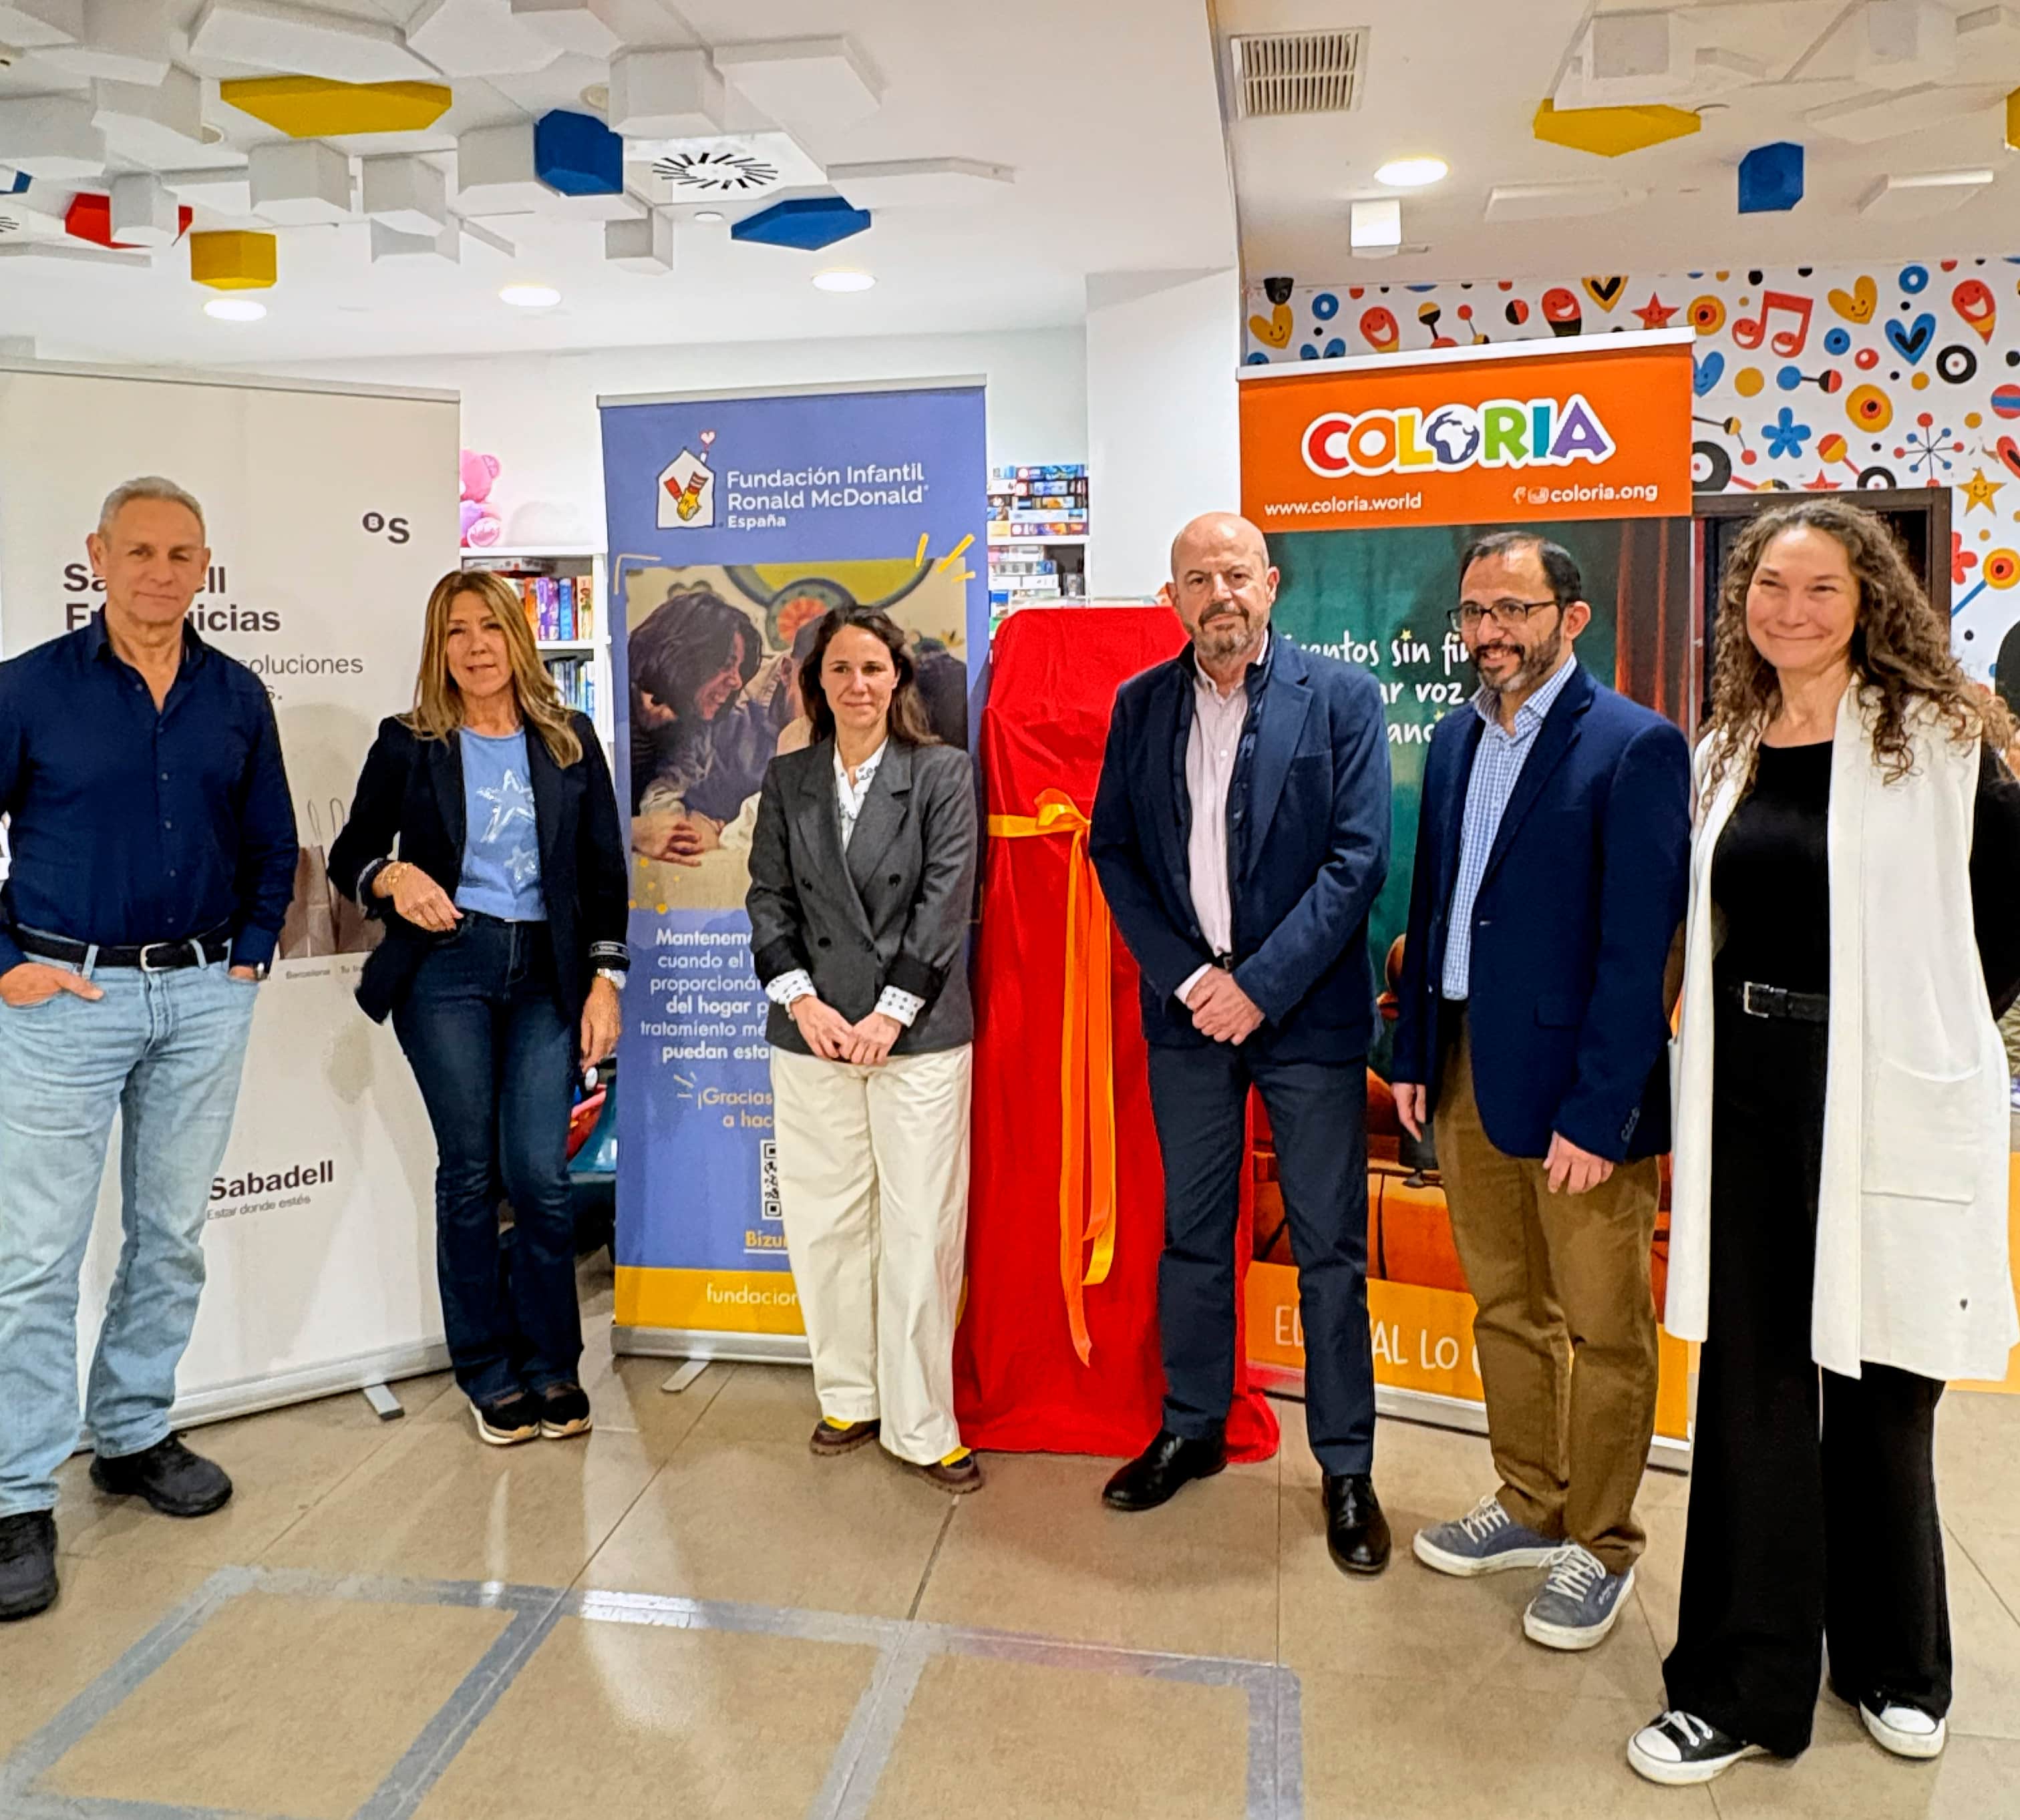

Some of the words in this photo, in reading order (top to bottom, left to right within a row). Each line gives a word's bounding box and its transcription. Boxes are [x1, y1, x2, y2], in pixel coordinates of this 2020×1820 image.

[1302, 394, 1616, 478] COLORIA
[727, 467, 840, 489] Fundación
[847, 462, 924, 484] Infantil
[728, 490, 804, 511] Ronald
[1550, 482, 1658, 502] coloria.ong
[1265, 492, 1422, 516] www.coloria.world
[727, 515, 786, 530] España
[1391, 639, 1431, 667] sin
[1415, 683, 1465, 705] voz
[657, 950, 723, 968] cuando
[728, 949, 743, 968] el
[665, 995, 692, 1014] del
[697, 995, 752, 1019] hogar
[641, 1019, 736, 1036] tratamiento
[662, 1040, 729, 1063] puedan
[733, 1044, 770, 1059] esta
[723, 1115, 734, 1127] a
[741, 1109, 774, 1128] hac
[209, 1160, 333, 1200] Sabadell
[206, 1208, 237, 1220] Estar
[239, 1201, 276, 1215] donde
[1421, 1329, 1459, 1370] LO
